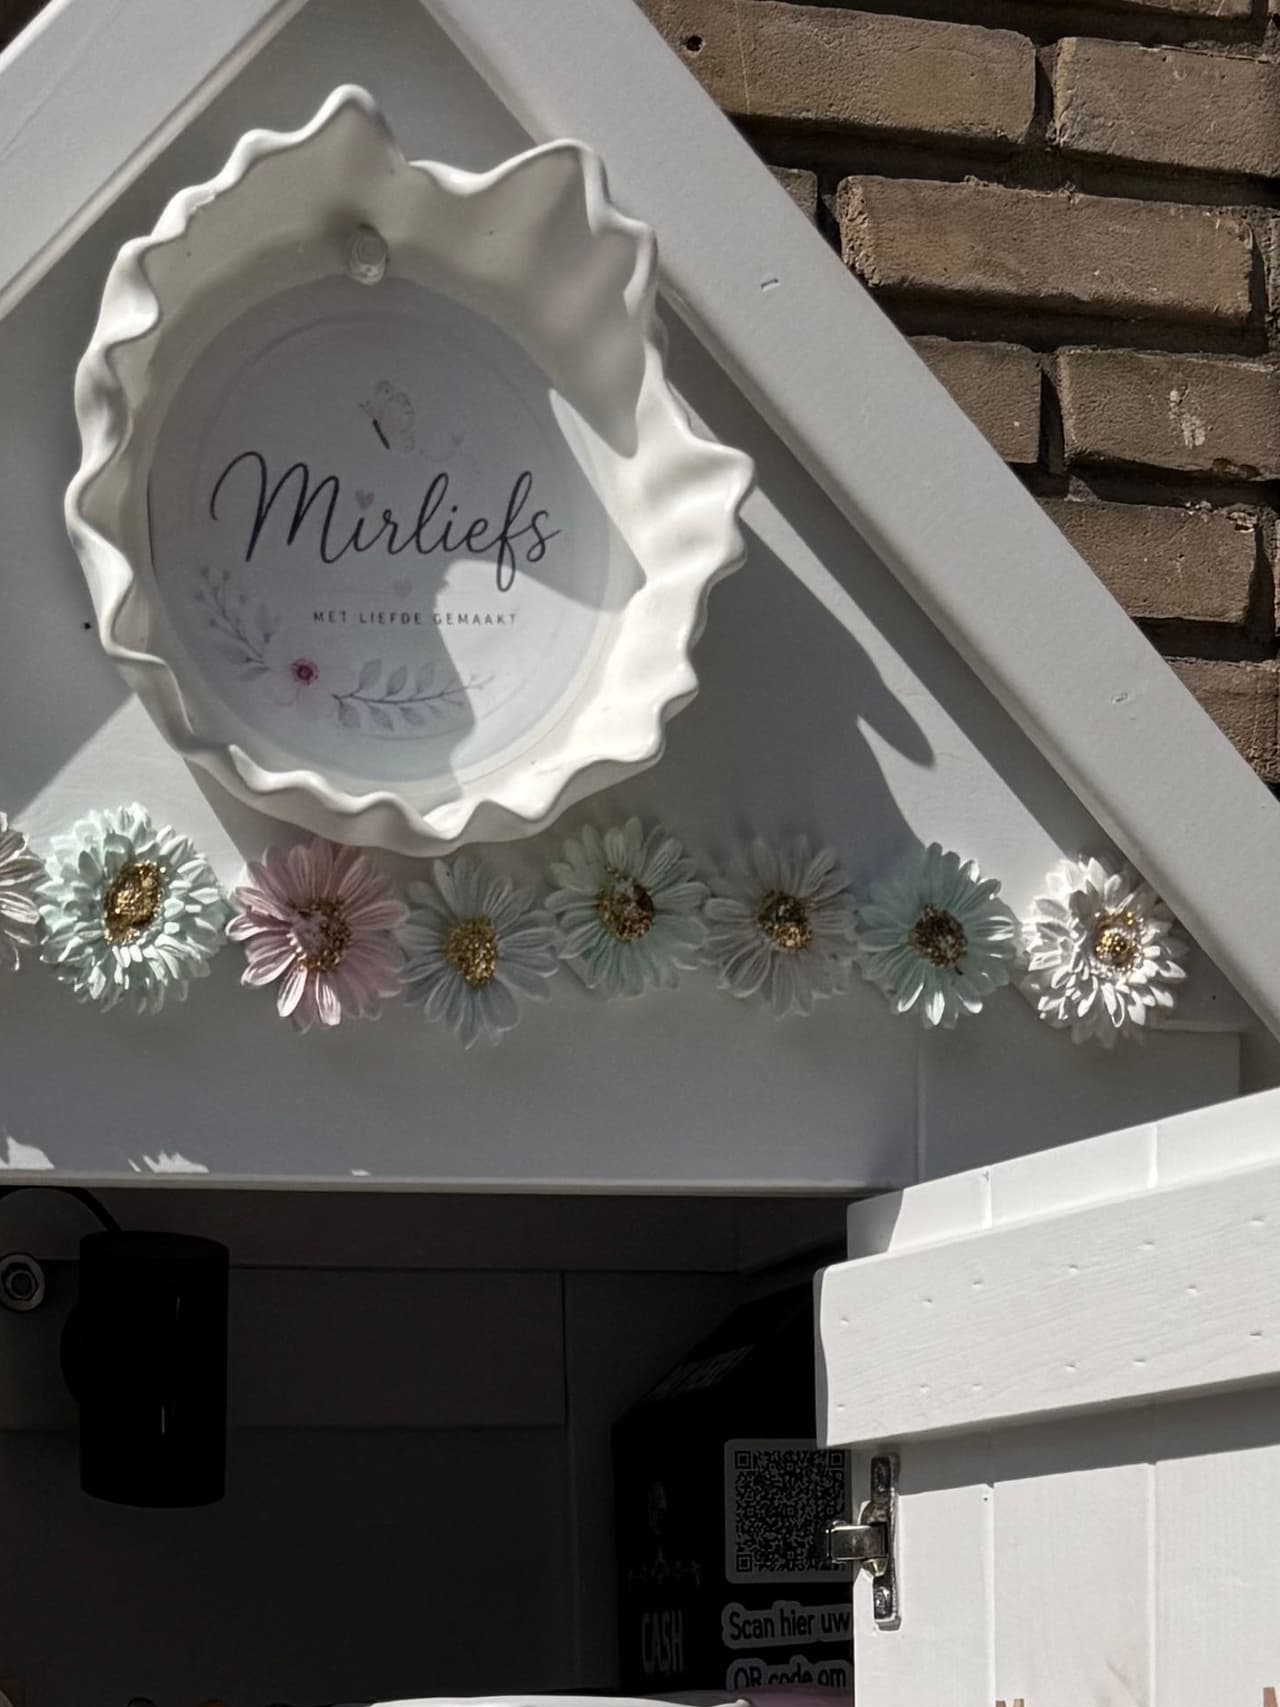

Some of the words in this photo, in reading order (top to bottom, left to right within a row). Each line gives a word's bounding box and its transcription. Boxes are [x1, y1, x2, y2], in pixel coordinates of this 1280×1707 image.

[209, 451, 561, 592] Mirliefs
[313, 610, 348, 625] MET
[360, 610, 422, 625] LIEFDE
[432, 611, 517, 626] GEMAAKT
[641, 1608, 685, 1678] CASH
[730, 1611, 775, 1641] Scan
[780, 1608, 814, 1637] hier
[821, 1611, 851, 1633] uw
